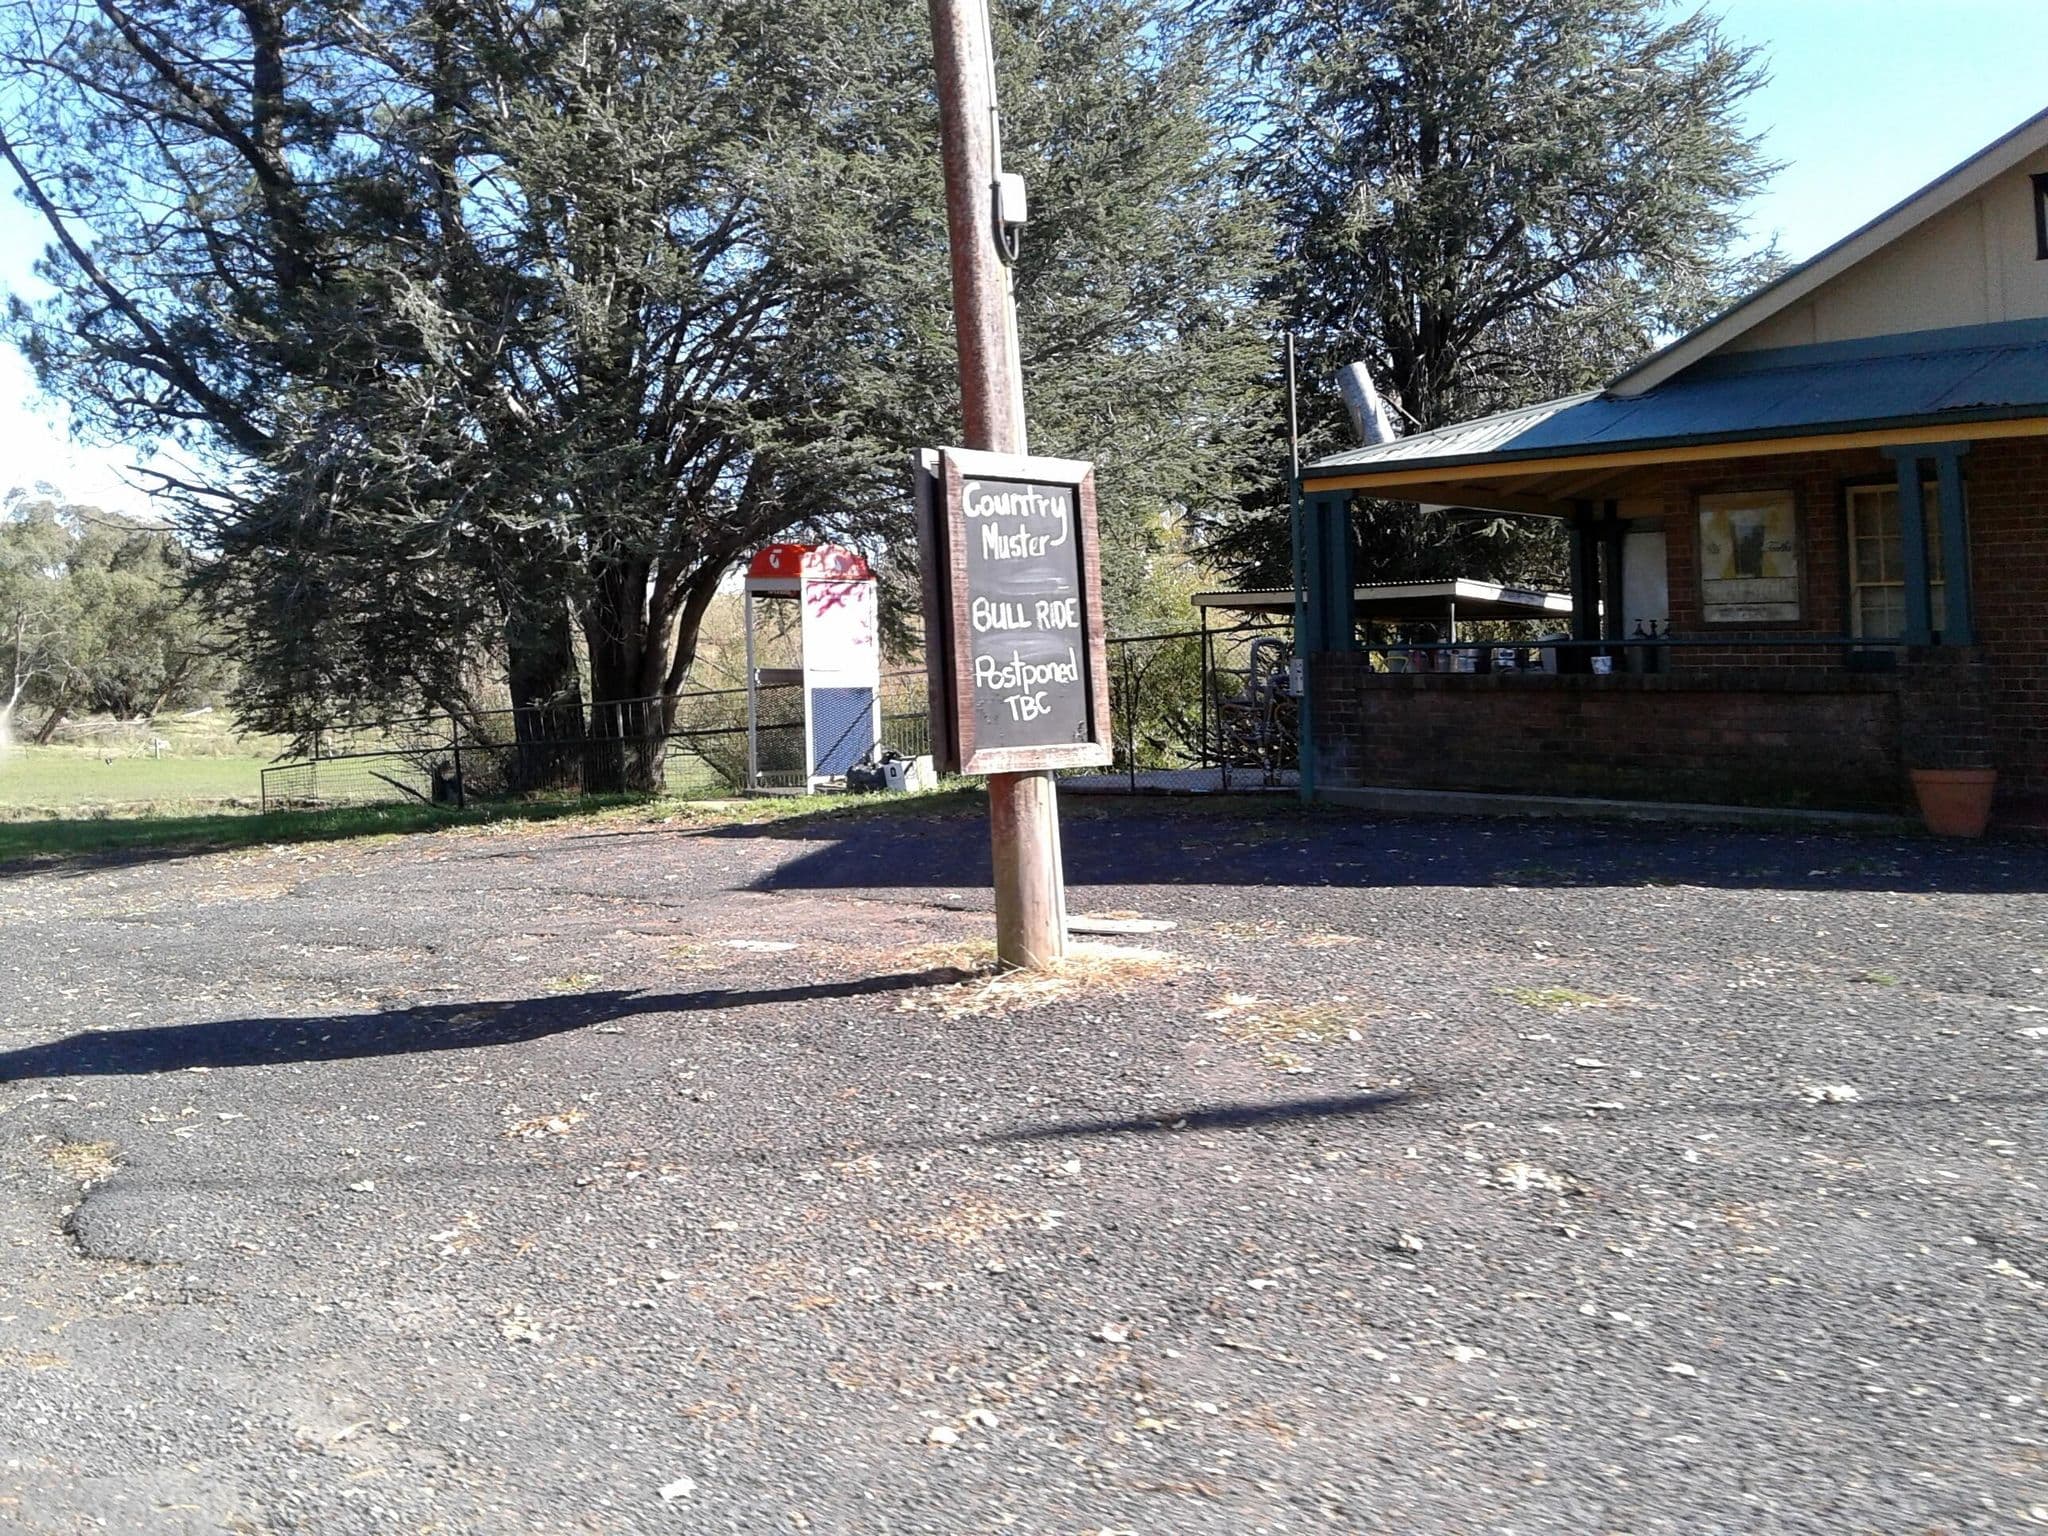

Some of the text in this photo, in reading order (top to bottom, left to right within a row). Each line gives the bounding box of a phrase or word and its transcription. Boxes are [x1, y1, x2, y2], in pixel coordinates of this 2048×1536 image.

[962, 482, 1068, 546] Country
[981, 522, 1050, 560] Muster
[972, 596, 1080, 633] BULL RIDE
[974, 647, 1079, 695] Postponed
[1003, 691, 1052, 721] TBC
